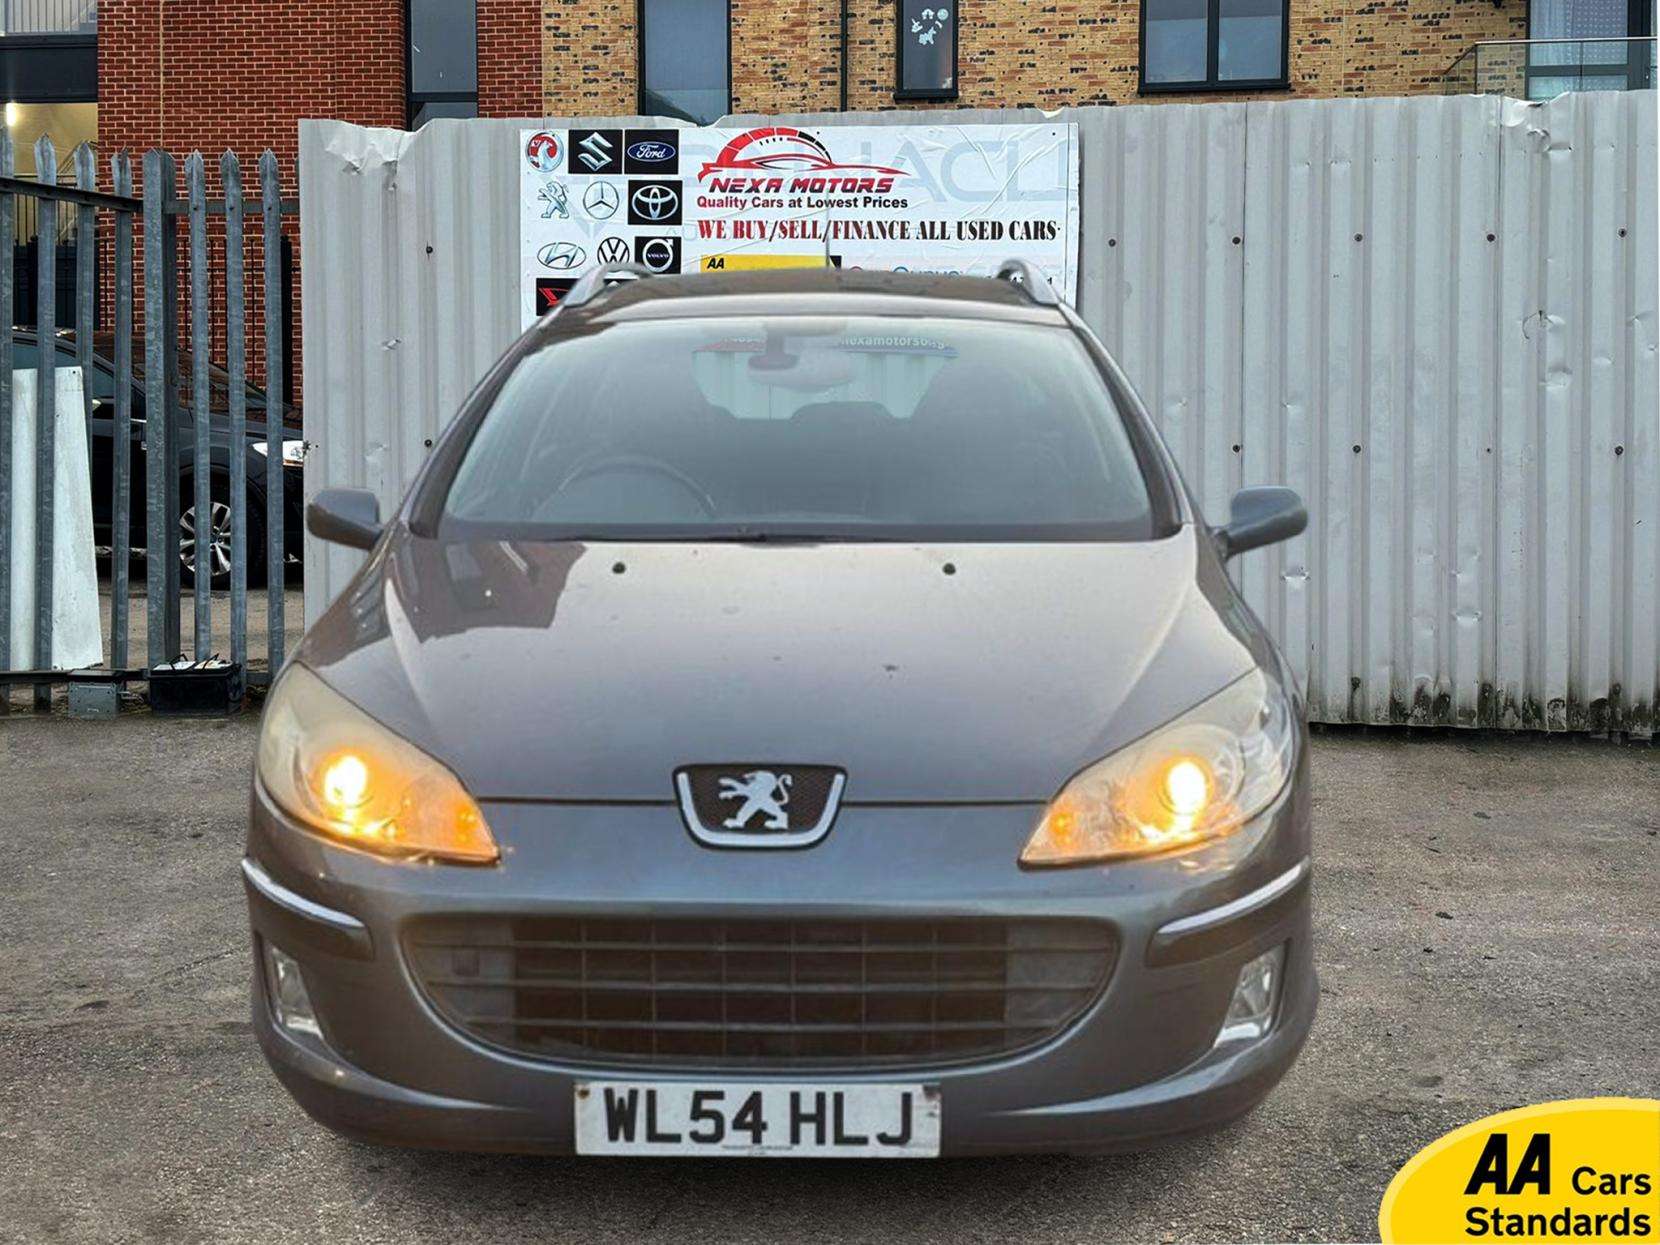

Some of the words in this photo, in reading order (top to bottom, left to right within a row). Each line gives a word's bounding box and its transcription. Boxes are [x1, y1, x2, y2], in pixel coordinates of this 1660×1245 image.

[636, 144, 666, 159] Ford
[708, 177, 783, 193] NEXA
[789, 177, 894, 193] MOTORS
[696, 195, 746, 210] Quality
[752, 195, 784, 208] Cars
[788, 196, 803, 208] at
[807, 195, 859, 208] Lowest
[863, 195, 908, 208] Prices
[698, 220, 727, 240] WE
[916, 220, 951, 240] ALL
[956, 220, 1004, 240] USED
[707, 257, 725, 269] AA
[604, 1087, 768, 1145] WL54
[789, 1090, 913, 1147] HLJ
